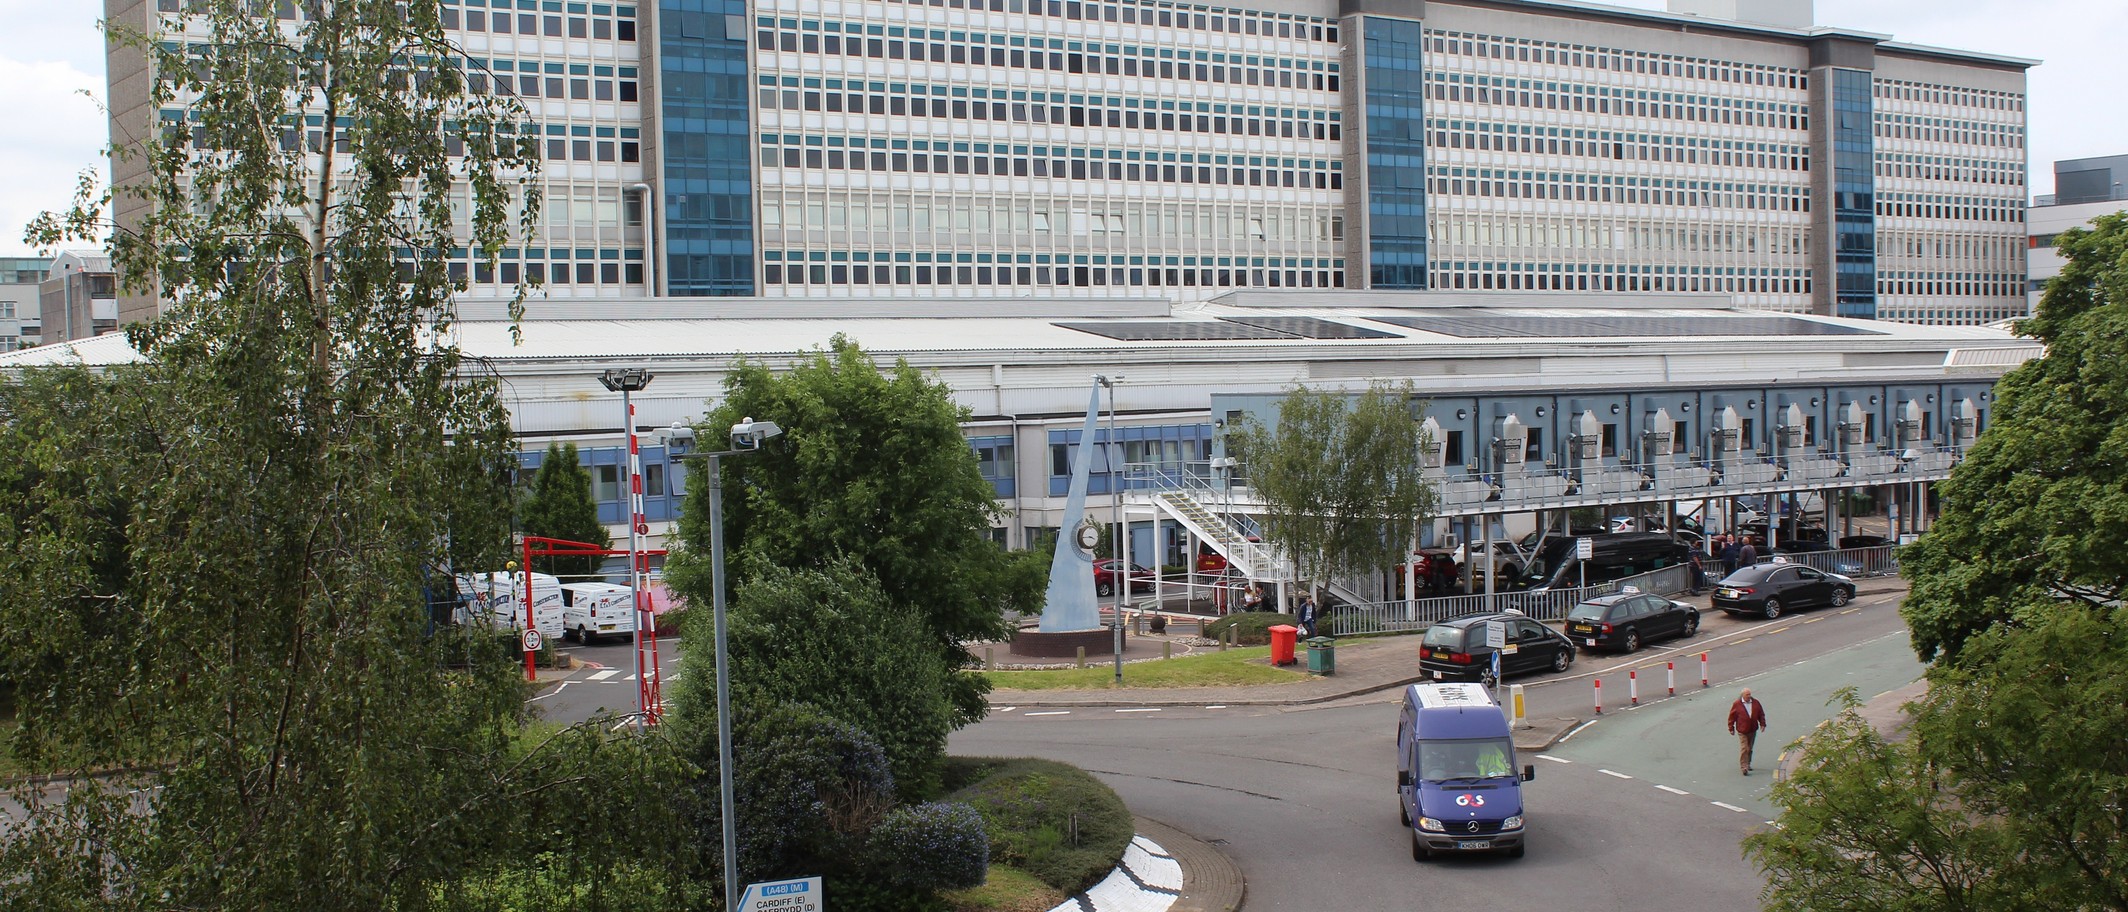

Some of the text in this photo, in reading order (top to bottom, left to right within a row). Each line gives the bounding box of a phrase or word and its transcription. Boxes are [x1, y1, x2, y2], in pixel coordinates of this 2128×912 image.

[1455, 793, 1485, 808] G4S
[767, 883, 803, 895] (A48) (M)
[756, 895, 805, 909] CARDIFF (E)
[804, 903, 815, 912] (D)
